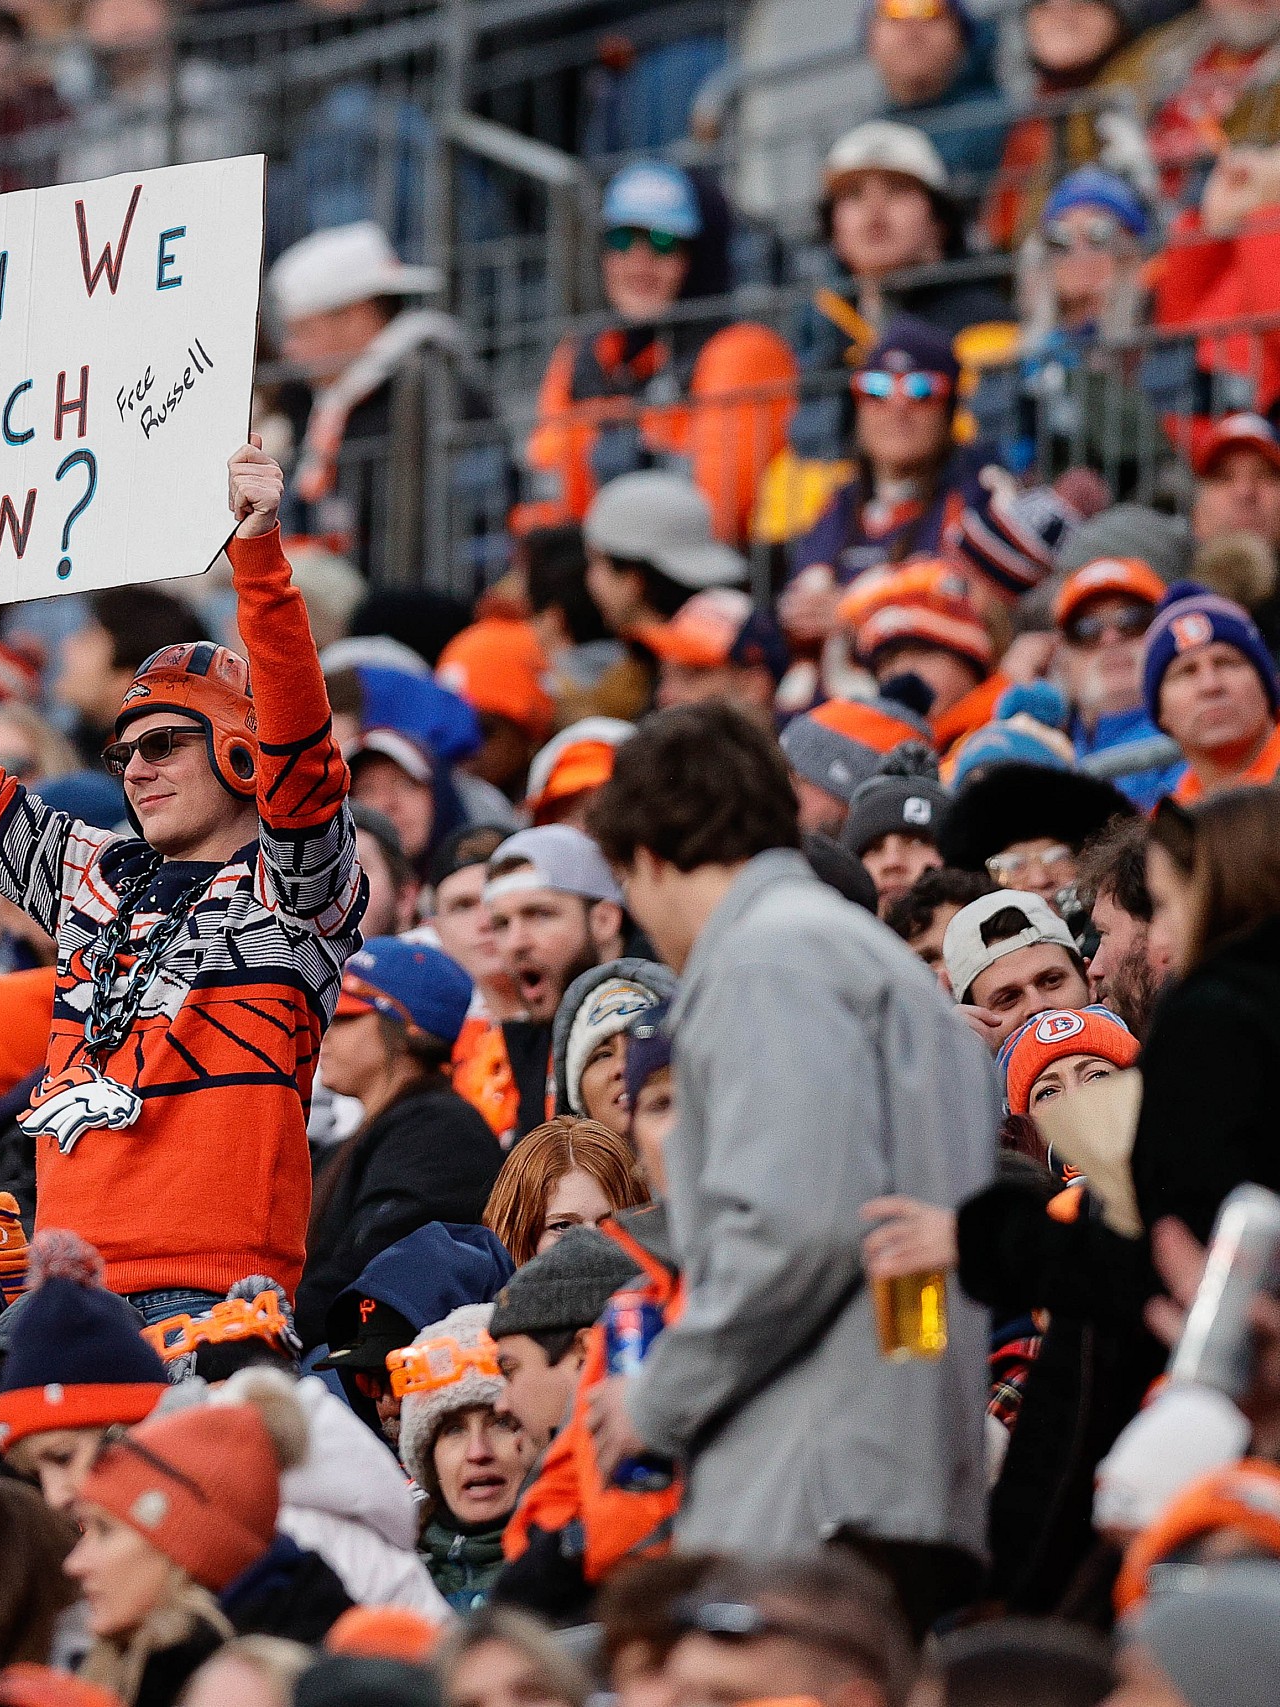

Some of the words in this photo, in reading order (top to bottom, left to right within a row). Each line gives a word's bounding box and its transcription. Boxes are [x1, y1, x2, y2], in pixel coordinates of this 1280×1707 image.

[74, 184, 187, 298] WE
[116, 365, 156, 423] Free
[140, 337, 214, 440] Russell
